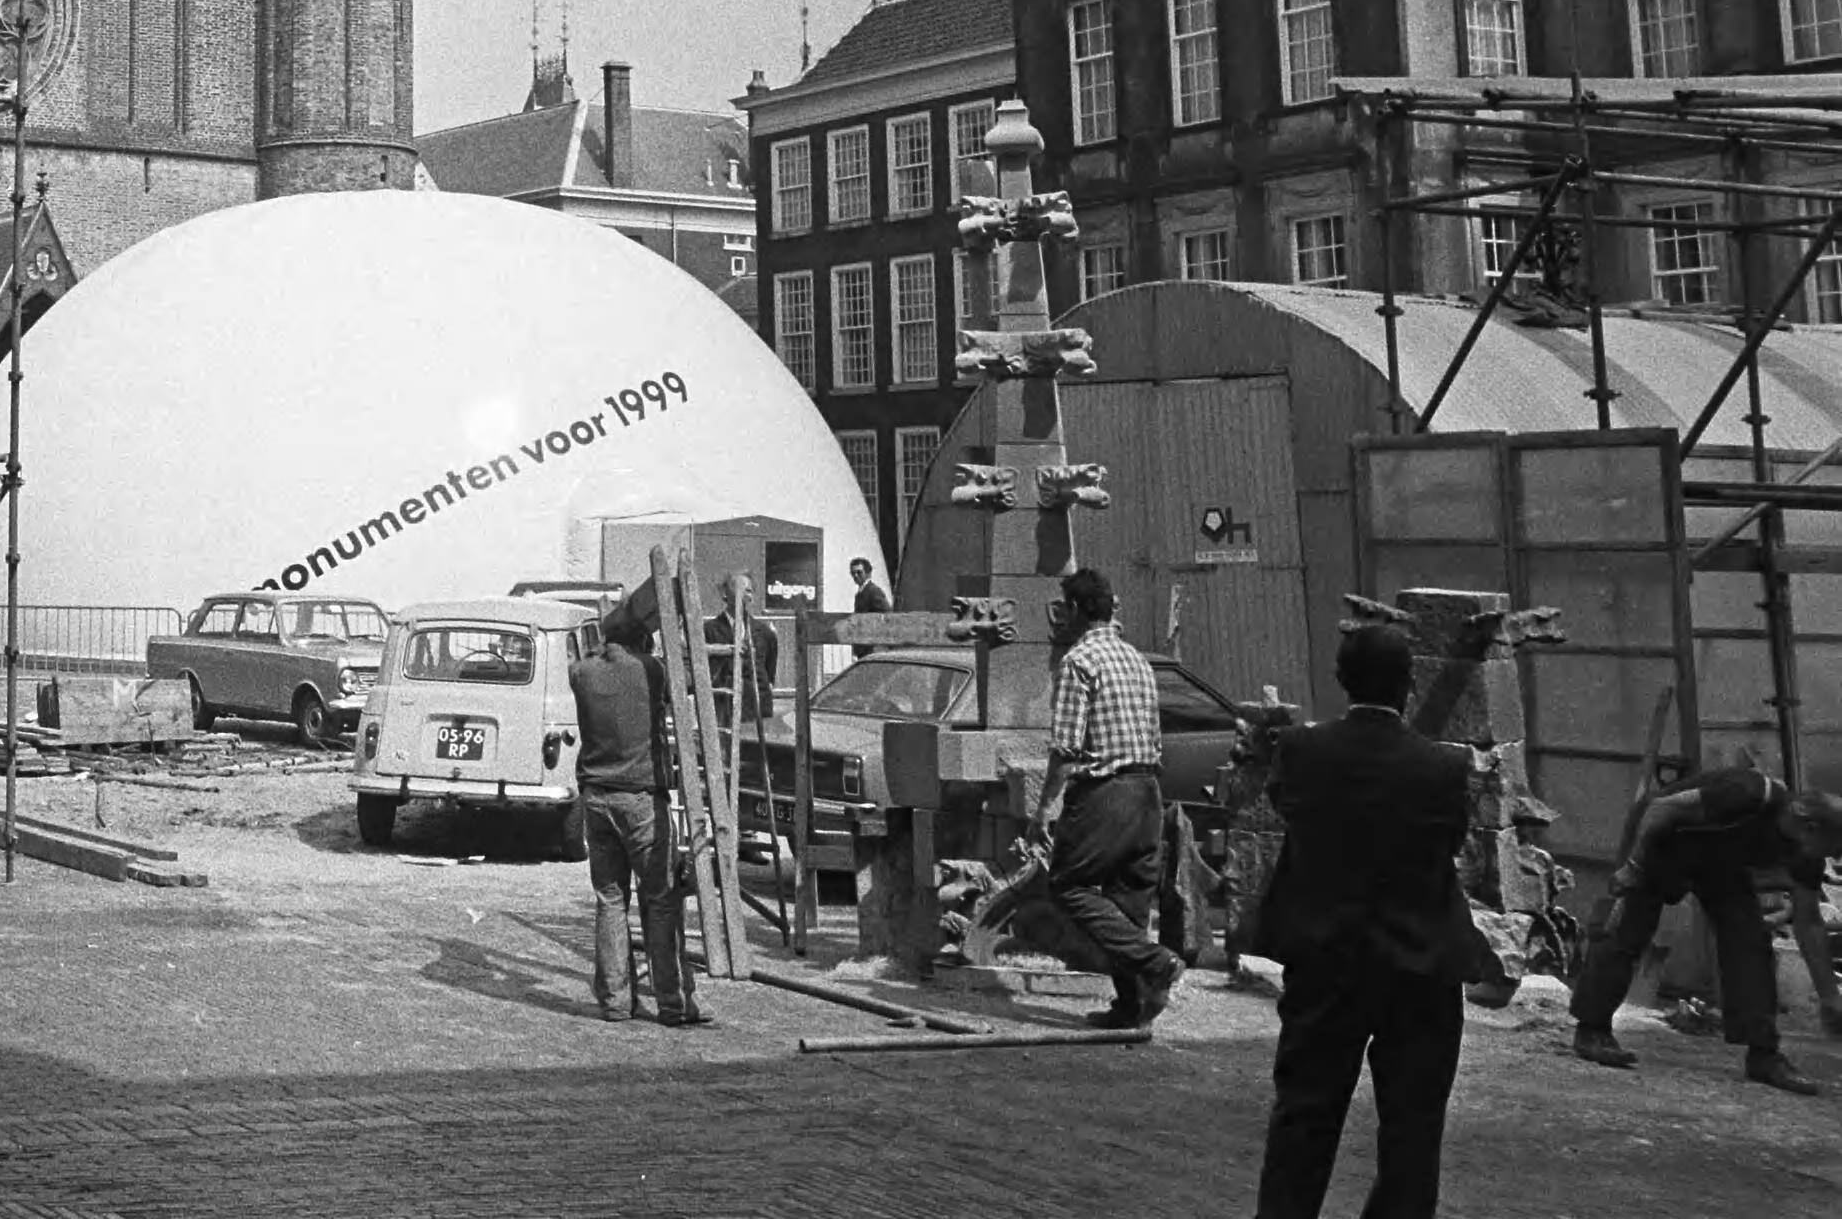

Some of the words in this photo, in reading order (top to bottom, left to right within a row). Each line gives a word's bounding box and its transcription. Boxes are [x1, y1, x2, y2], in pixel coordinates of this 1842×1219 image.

[520, 412, 607, 463] voor
[604, 371, 688, 427] 1999
[767, 580, 816, 600] uitgang
[439, 728, 484, 744] 05-96
[448, 743, 469, 757] RP
